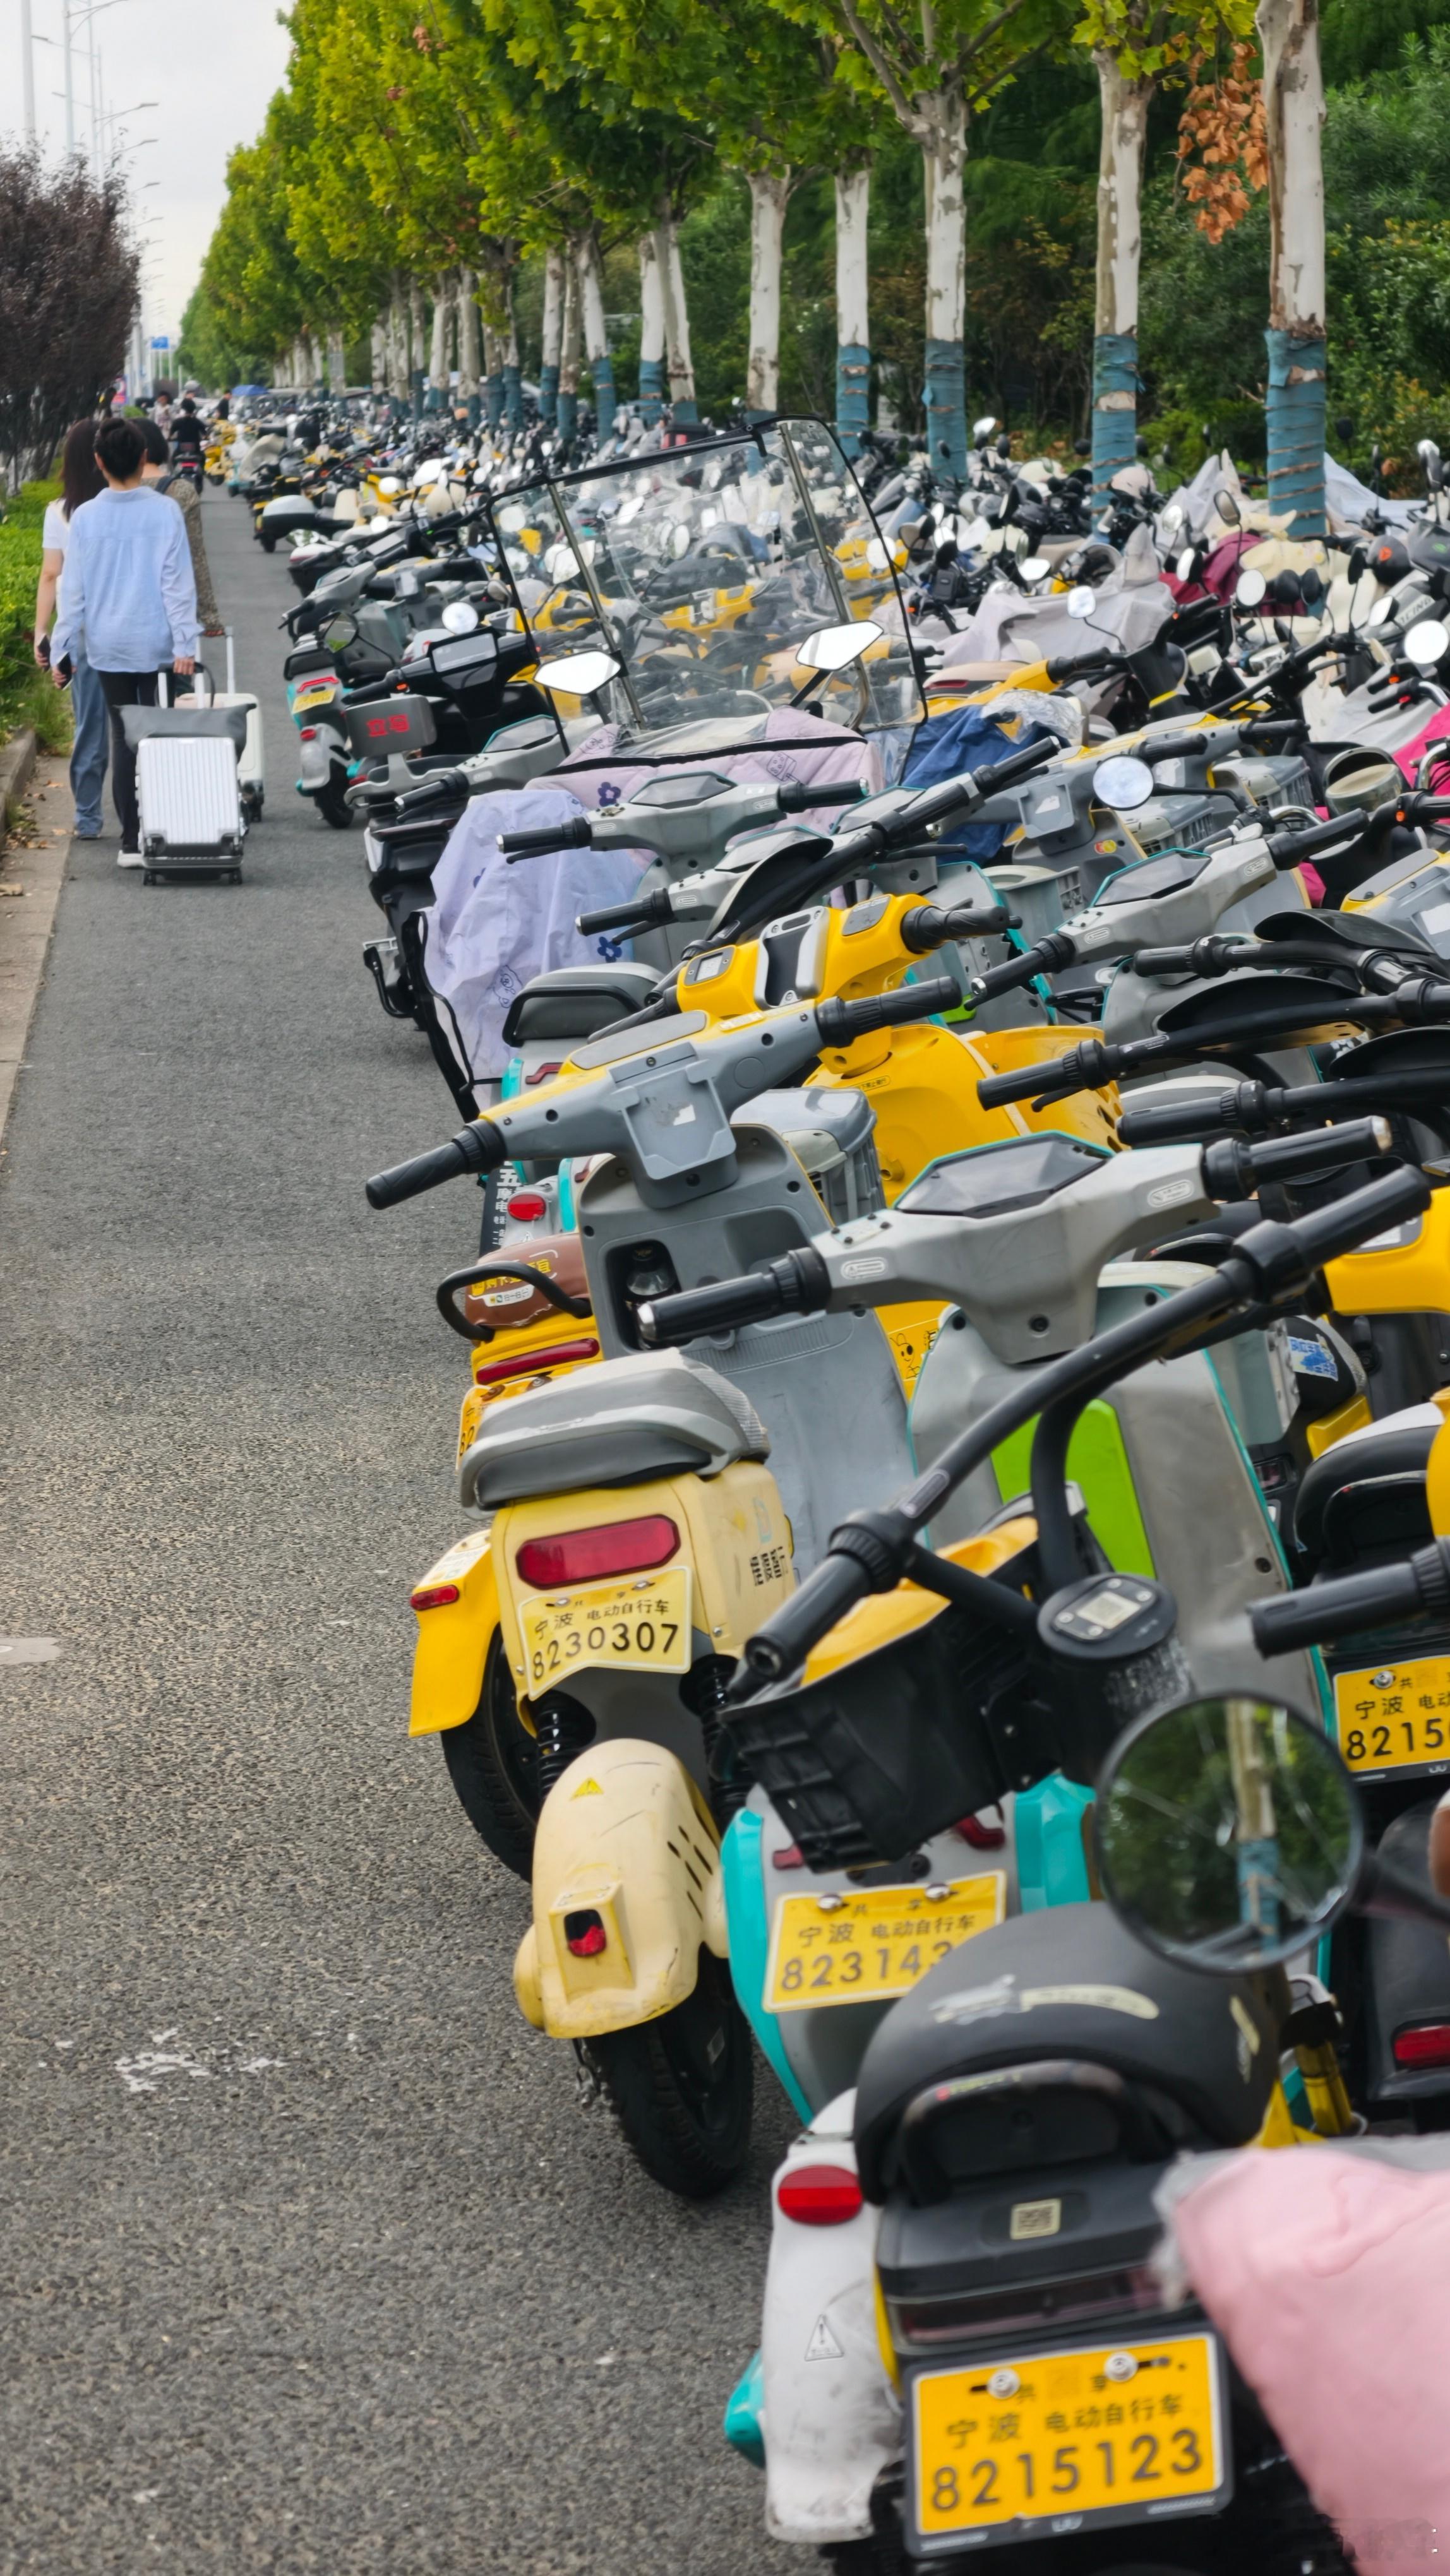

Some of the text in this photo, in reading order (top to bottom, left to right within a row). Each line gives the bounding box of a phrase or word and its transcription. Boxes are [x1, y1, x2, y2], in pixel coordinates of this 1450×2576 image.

[535, 1599, 669, 1640] 宁波 电动自行车
[533, 1621, 679, 1680] 8230307
[1355, 1695, 1404, 1720] 宁波
[1346, 1717, 1450, 1760] 8215
[798, 1915, 976, 1949] 宁波 电动自行车
[947, 2393, 1183, 2450] 宁波 电动自行车
[931, 2428, 1202, 2511] 8215123
